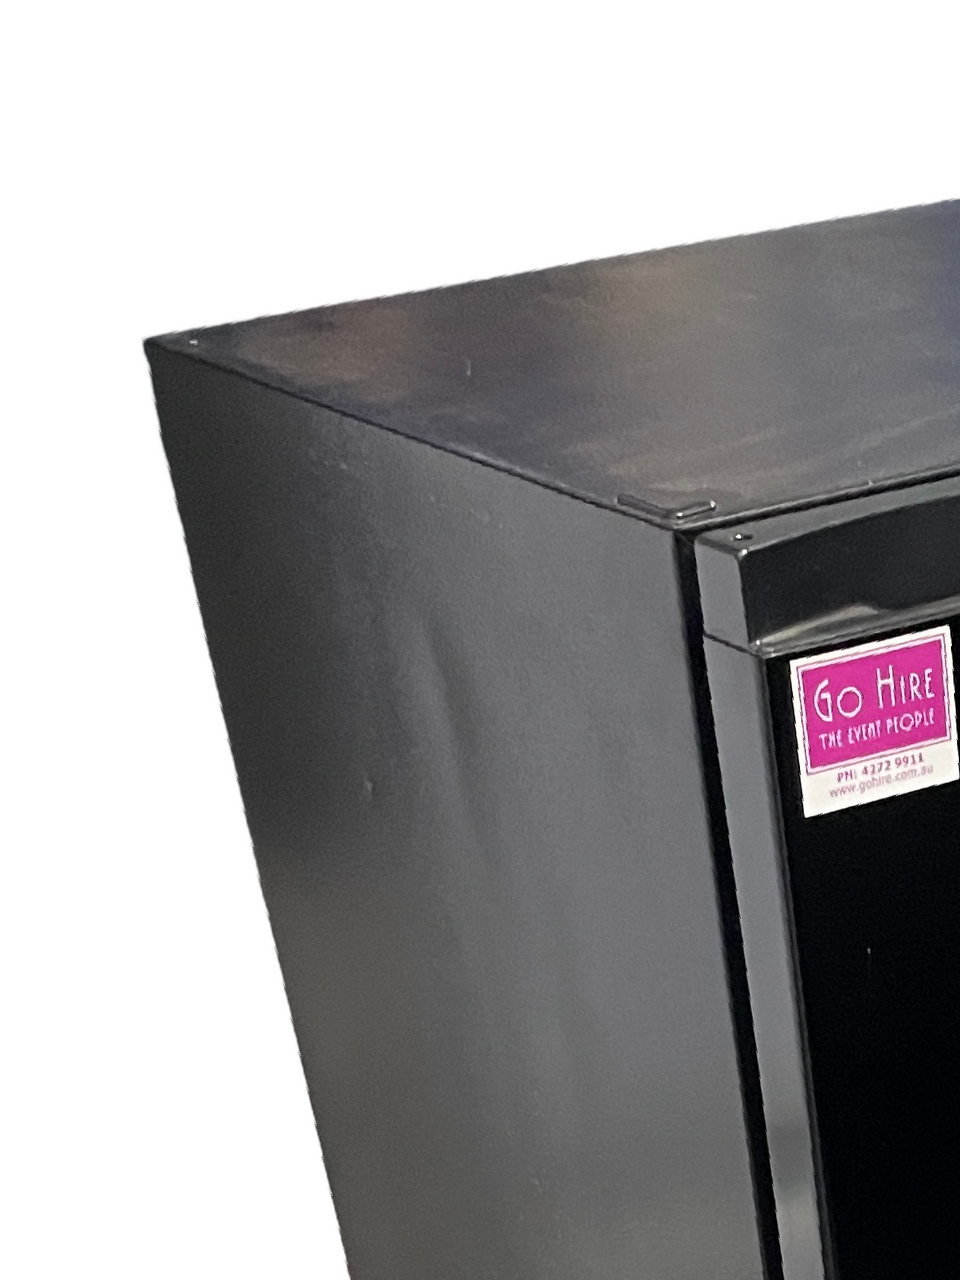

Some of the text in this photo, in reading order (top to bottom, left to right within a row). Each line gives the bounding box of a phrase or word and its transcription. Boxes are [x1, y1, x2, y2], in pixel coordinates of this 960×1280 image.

[819, 708, 935, 750] THE EVENT PEOPLE
[862, 760, 891, 776] 4272
[895, 753, 924, 769] 9911
[828, 765, 934, 798] www.gohire.com.au
